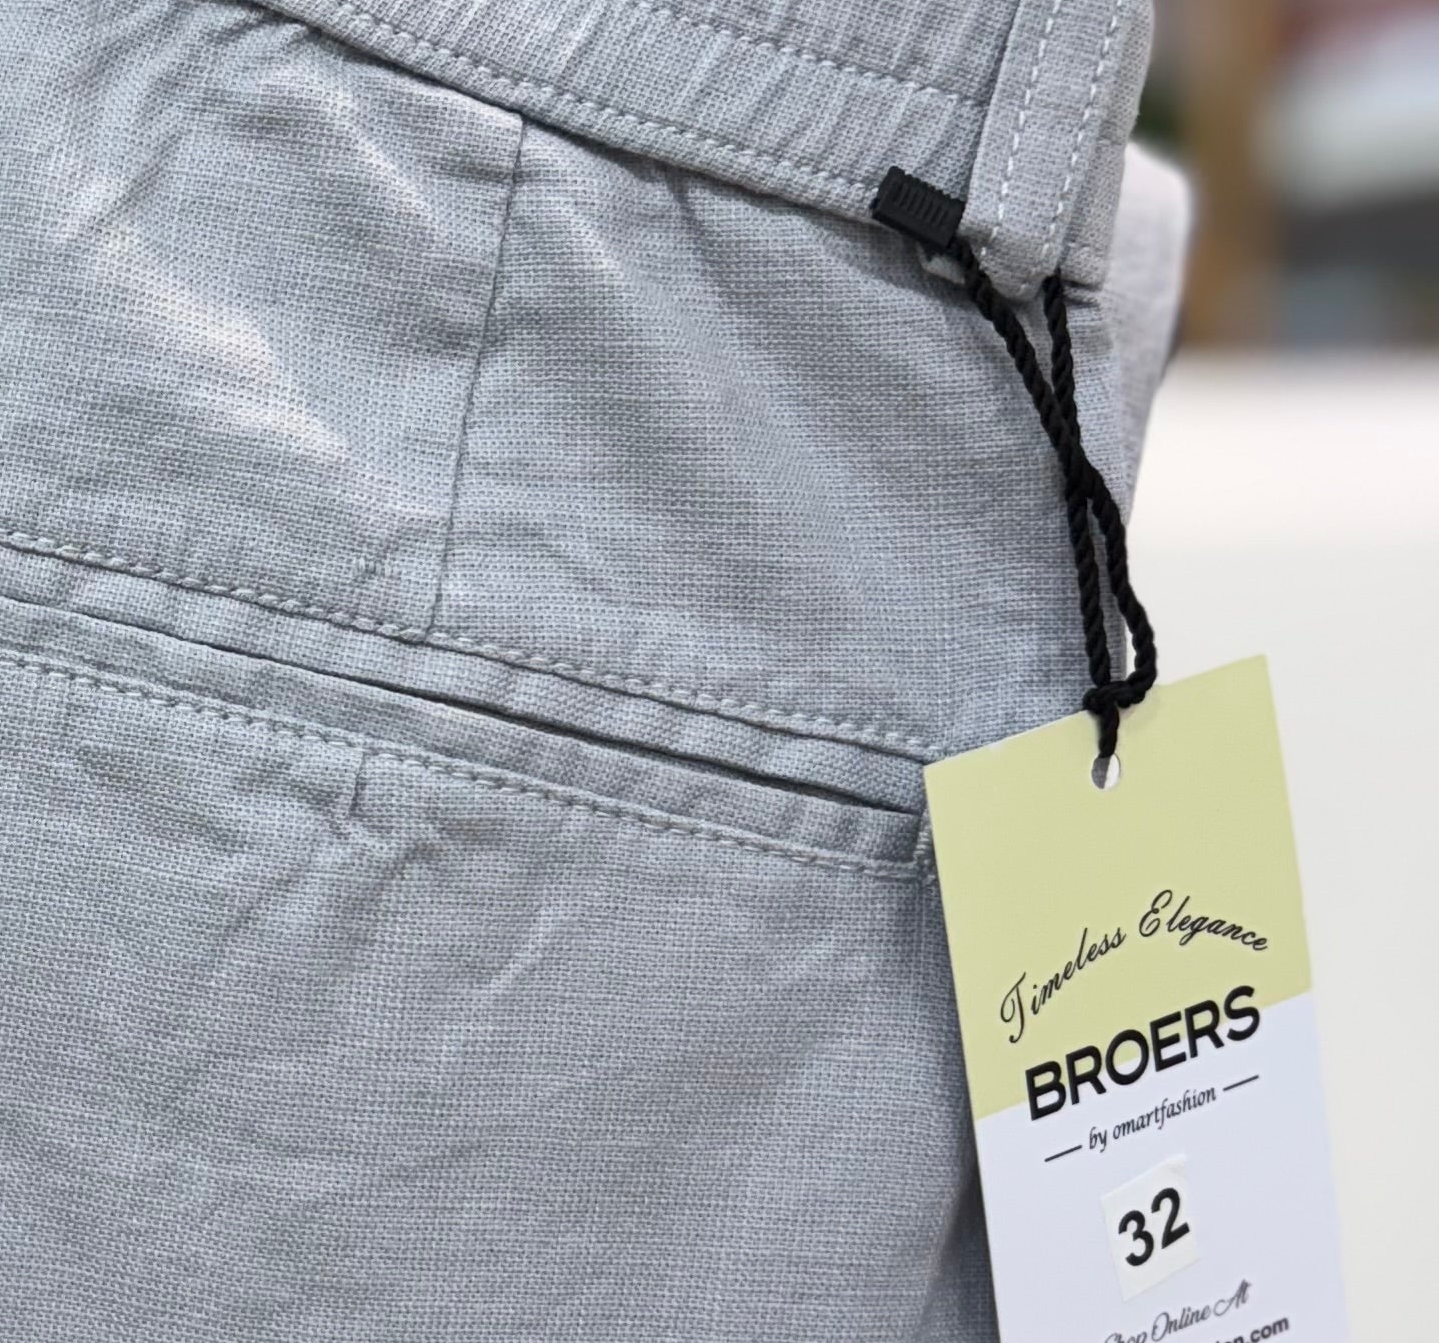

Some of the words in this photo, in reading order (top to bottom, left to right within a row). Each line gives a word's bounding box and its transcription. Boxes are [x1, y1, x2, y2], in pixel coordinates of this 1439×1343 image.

[1000, 927, 1127, 1044] Timeless
[1138, 889, 1269, 951] Elegance
[1024, 985, 1261, 1121] BROERS
[1088, 1127, 1108, 1153] by
[1112, 1086, 1217, 1130] omartfashion
[1118, 1187, 1191, 1267] 32
[1151, 1305, 1211, 1342] Online
[1213, 1279, 1252, 1317] At
